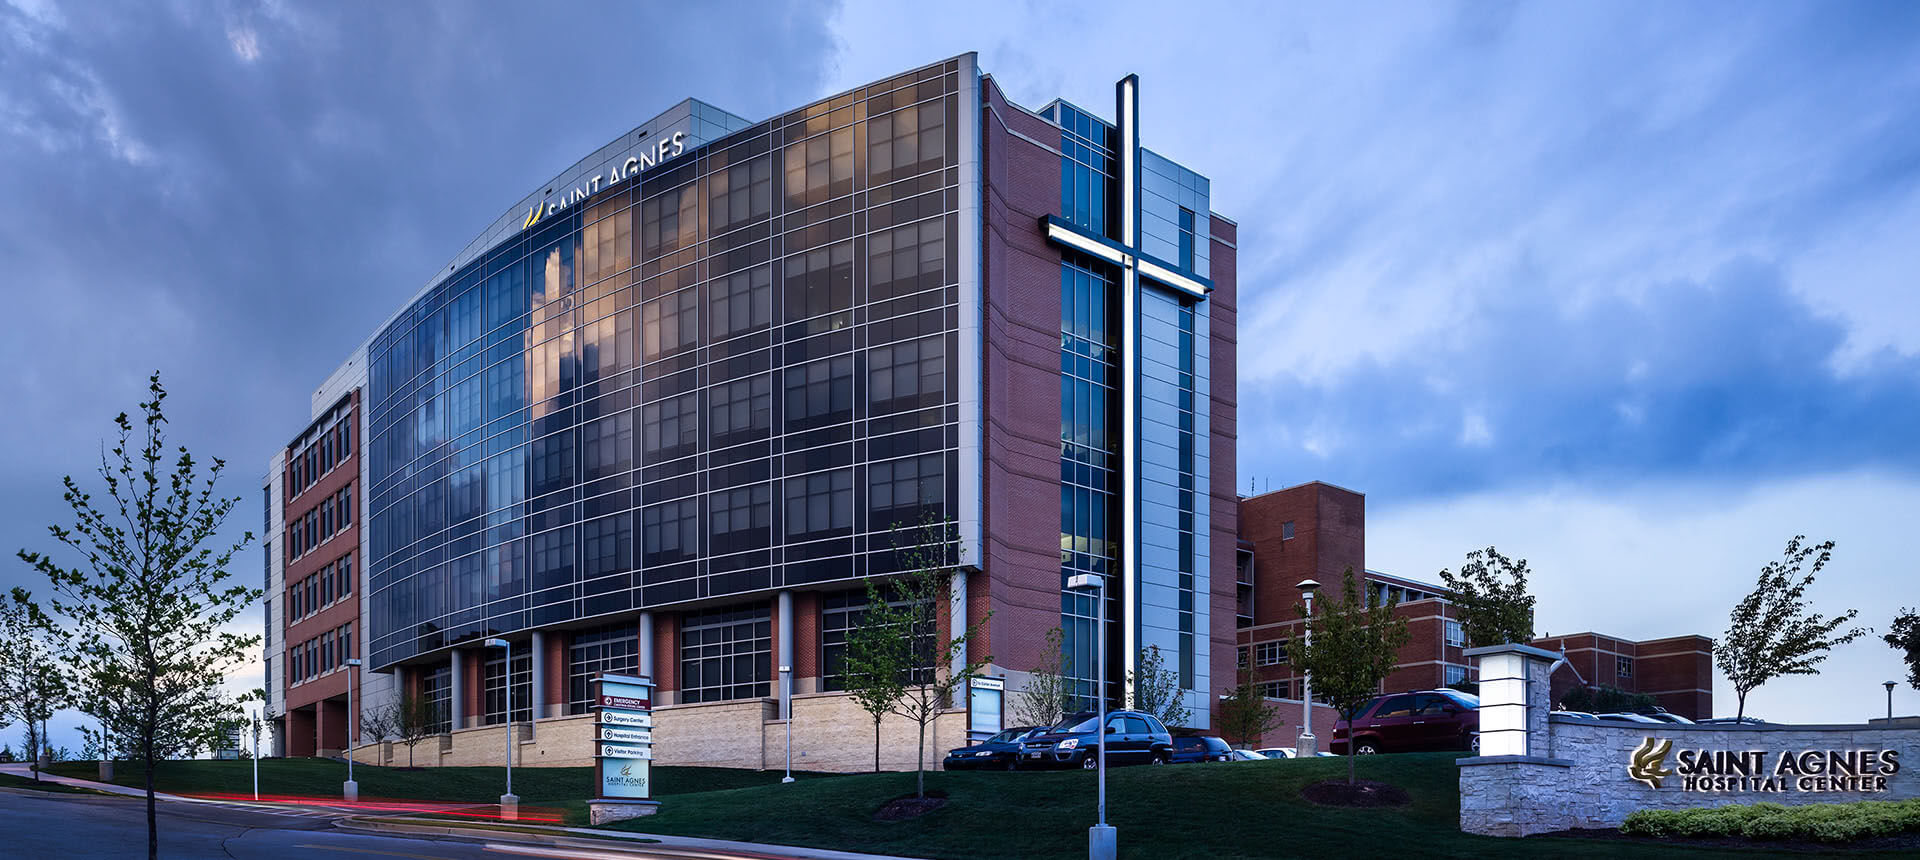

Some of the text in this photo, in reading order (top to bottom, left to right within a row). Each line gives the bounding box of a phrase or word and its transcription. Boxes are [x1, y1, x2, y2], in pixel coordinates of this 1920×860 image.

[609, 131, 683, 185] AGNES
[1677, 750, 1901, 775] SAINT AGNES
[1685, 776, 1888, 792] HOSPITAL CENTER
